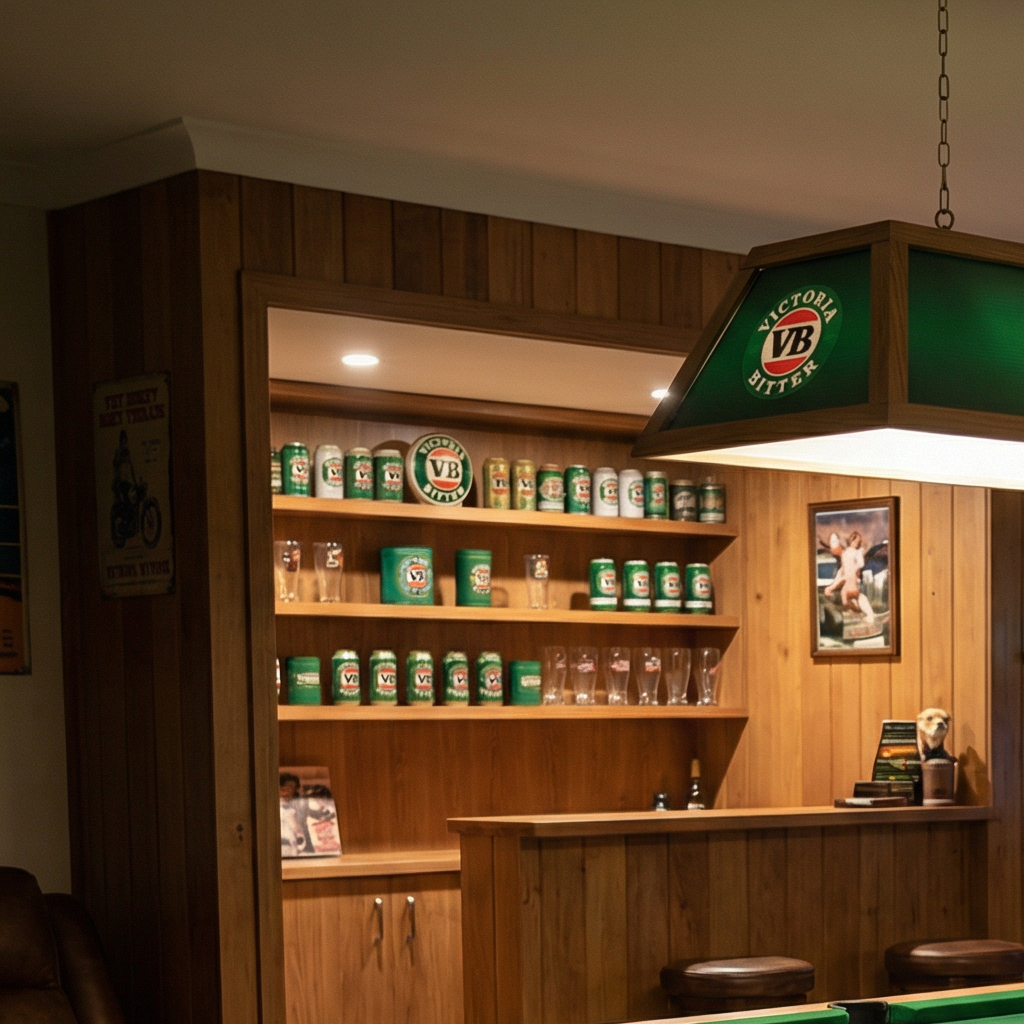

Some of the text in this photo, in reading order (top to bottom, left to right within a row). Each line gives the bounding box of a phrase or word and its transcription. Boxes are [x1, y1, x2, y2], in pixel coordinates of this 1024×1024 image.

[757, 289, 838, 324] VICTORIA
[771, 324, 815, 359] VB
[747, 359, 819, 396] BITTER
[429, 458, 460, 479] VB
